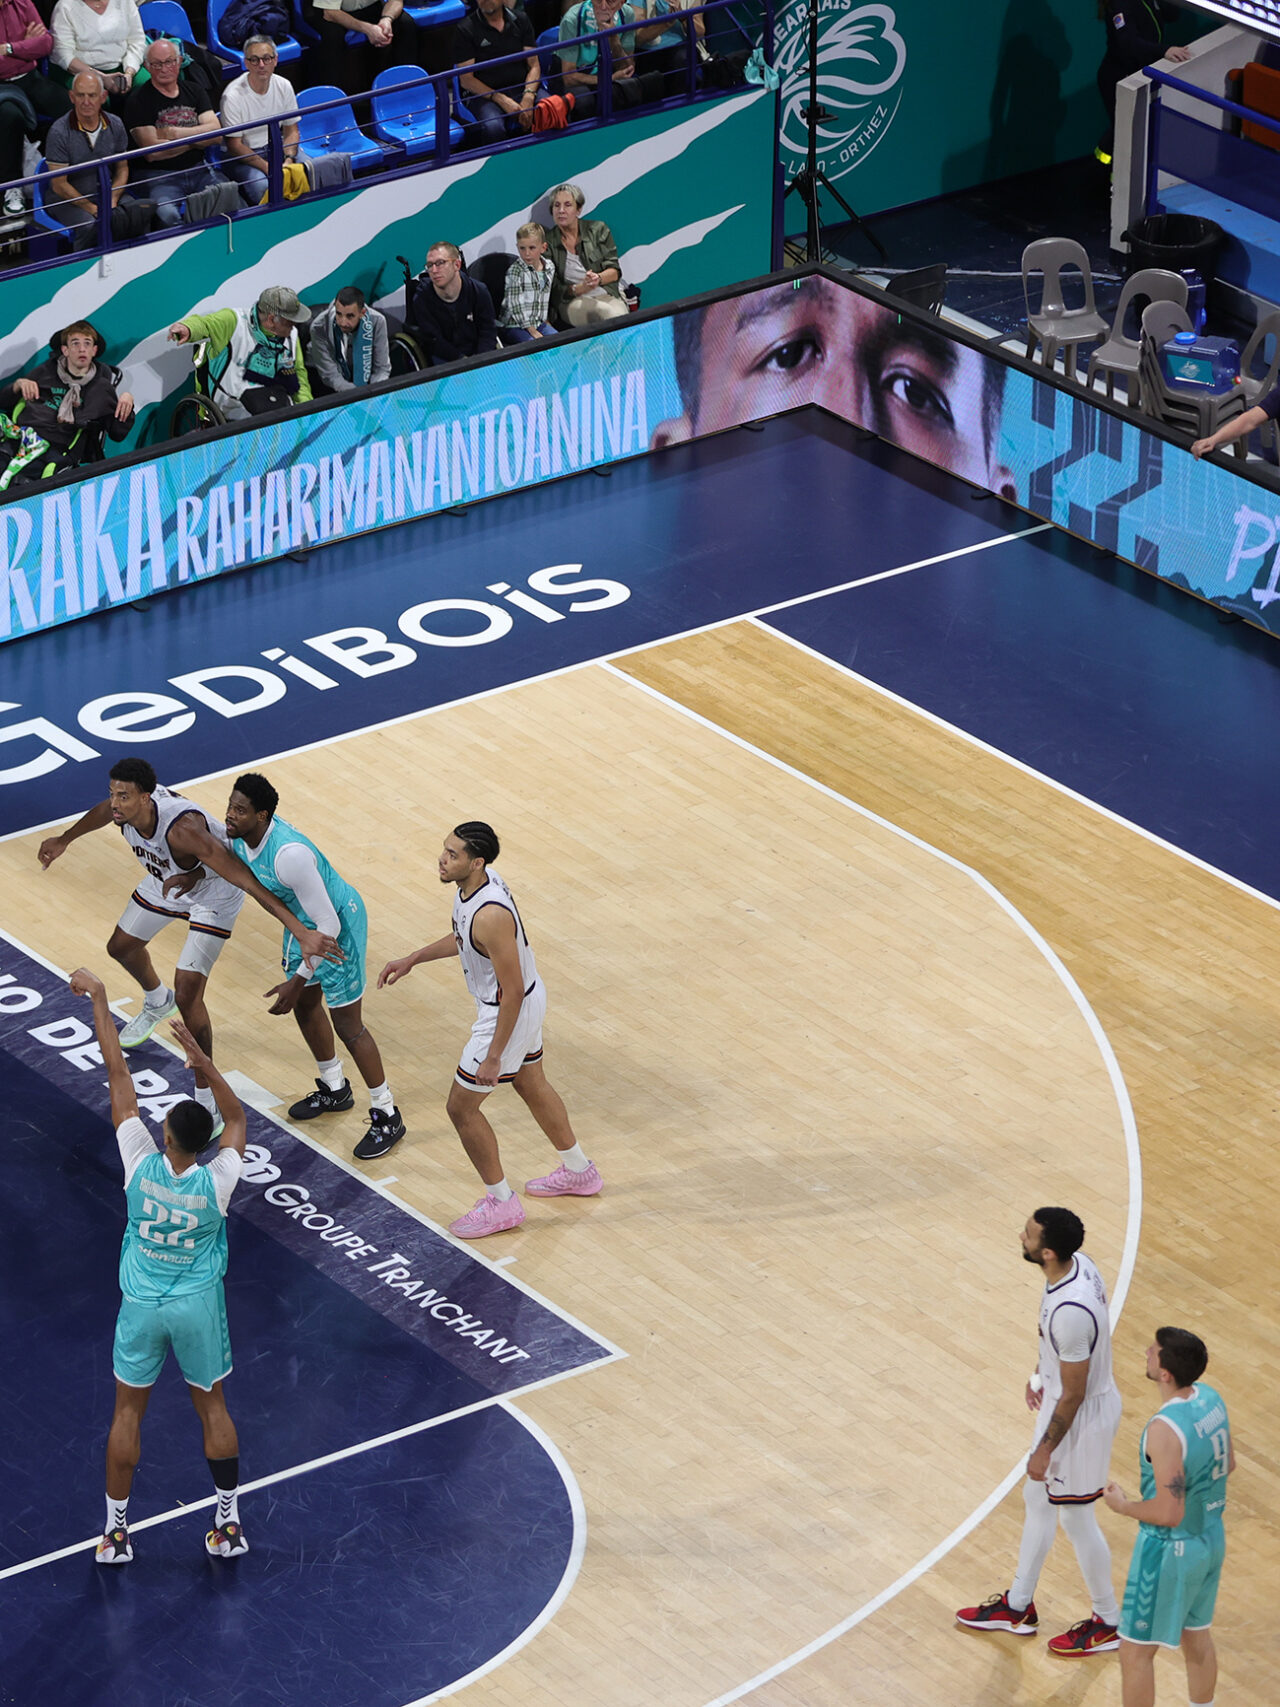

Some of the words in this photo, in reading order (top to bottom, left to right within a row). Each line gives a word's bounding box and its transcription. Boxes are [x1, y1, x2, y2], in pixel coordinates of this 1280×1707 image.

[839, 105, 889, 164] ORTHEZ
[27, 1016, 131, 1072] DE
[103, 1069, 195, 1123] PA
[264, 1184, 378, 1260] GROUPE
[367, 1252, 531, 1364] TRANCHANT
[138, 1196, 199, 1249] 22
